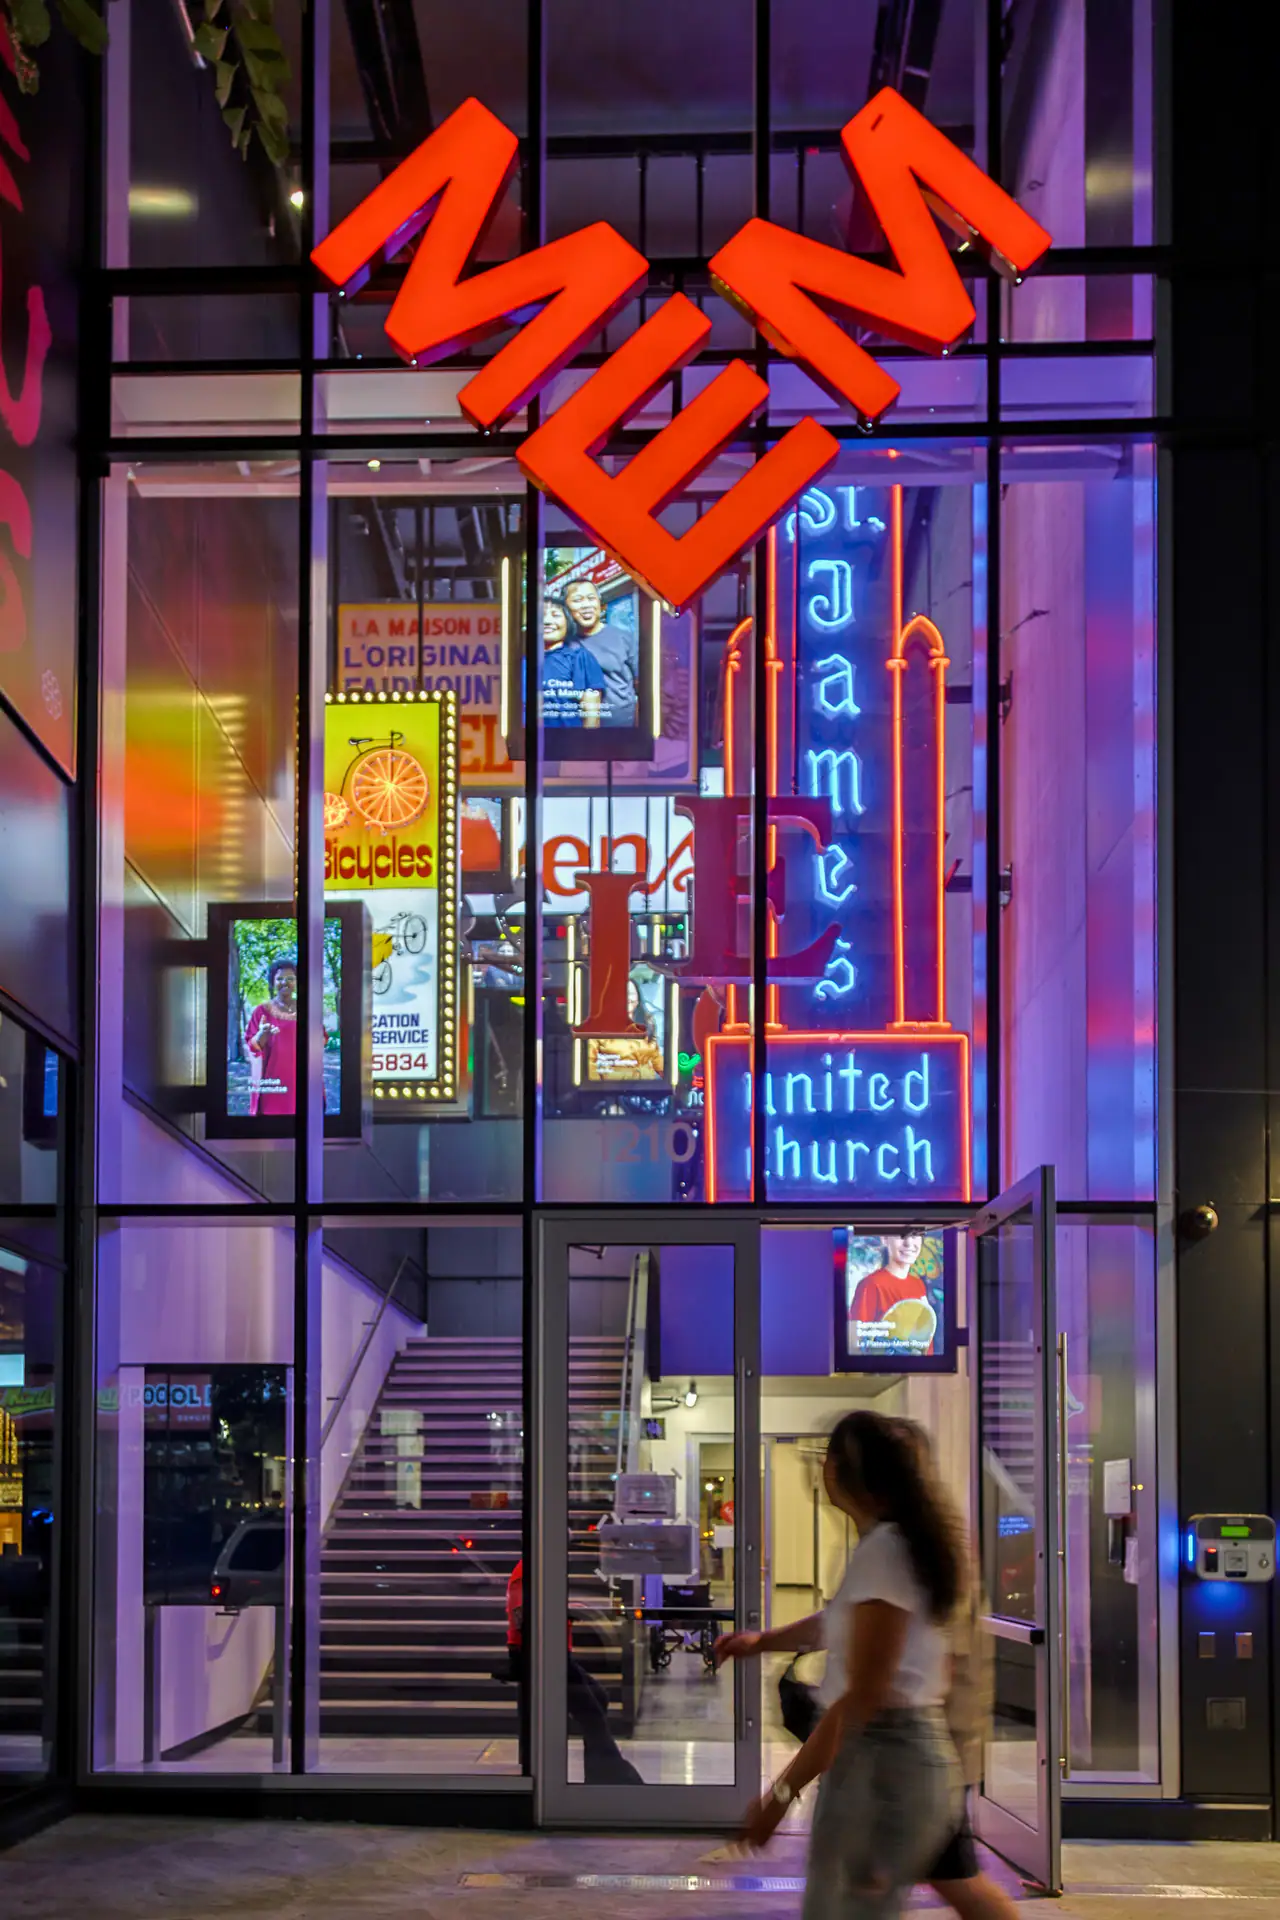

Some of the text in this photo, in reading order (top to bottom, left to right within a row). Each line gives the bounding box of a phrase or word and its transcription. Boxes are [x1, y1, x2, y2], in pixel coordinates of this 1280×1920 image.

[351, 618, 380, 637] LA
[388, 617, 471, 637] MAISON
[372, 1029, 429, 1044] SERVICE
[745, 1053, 930, 1115] united
